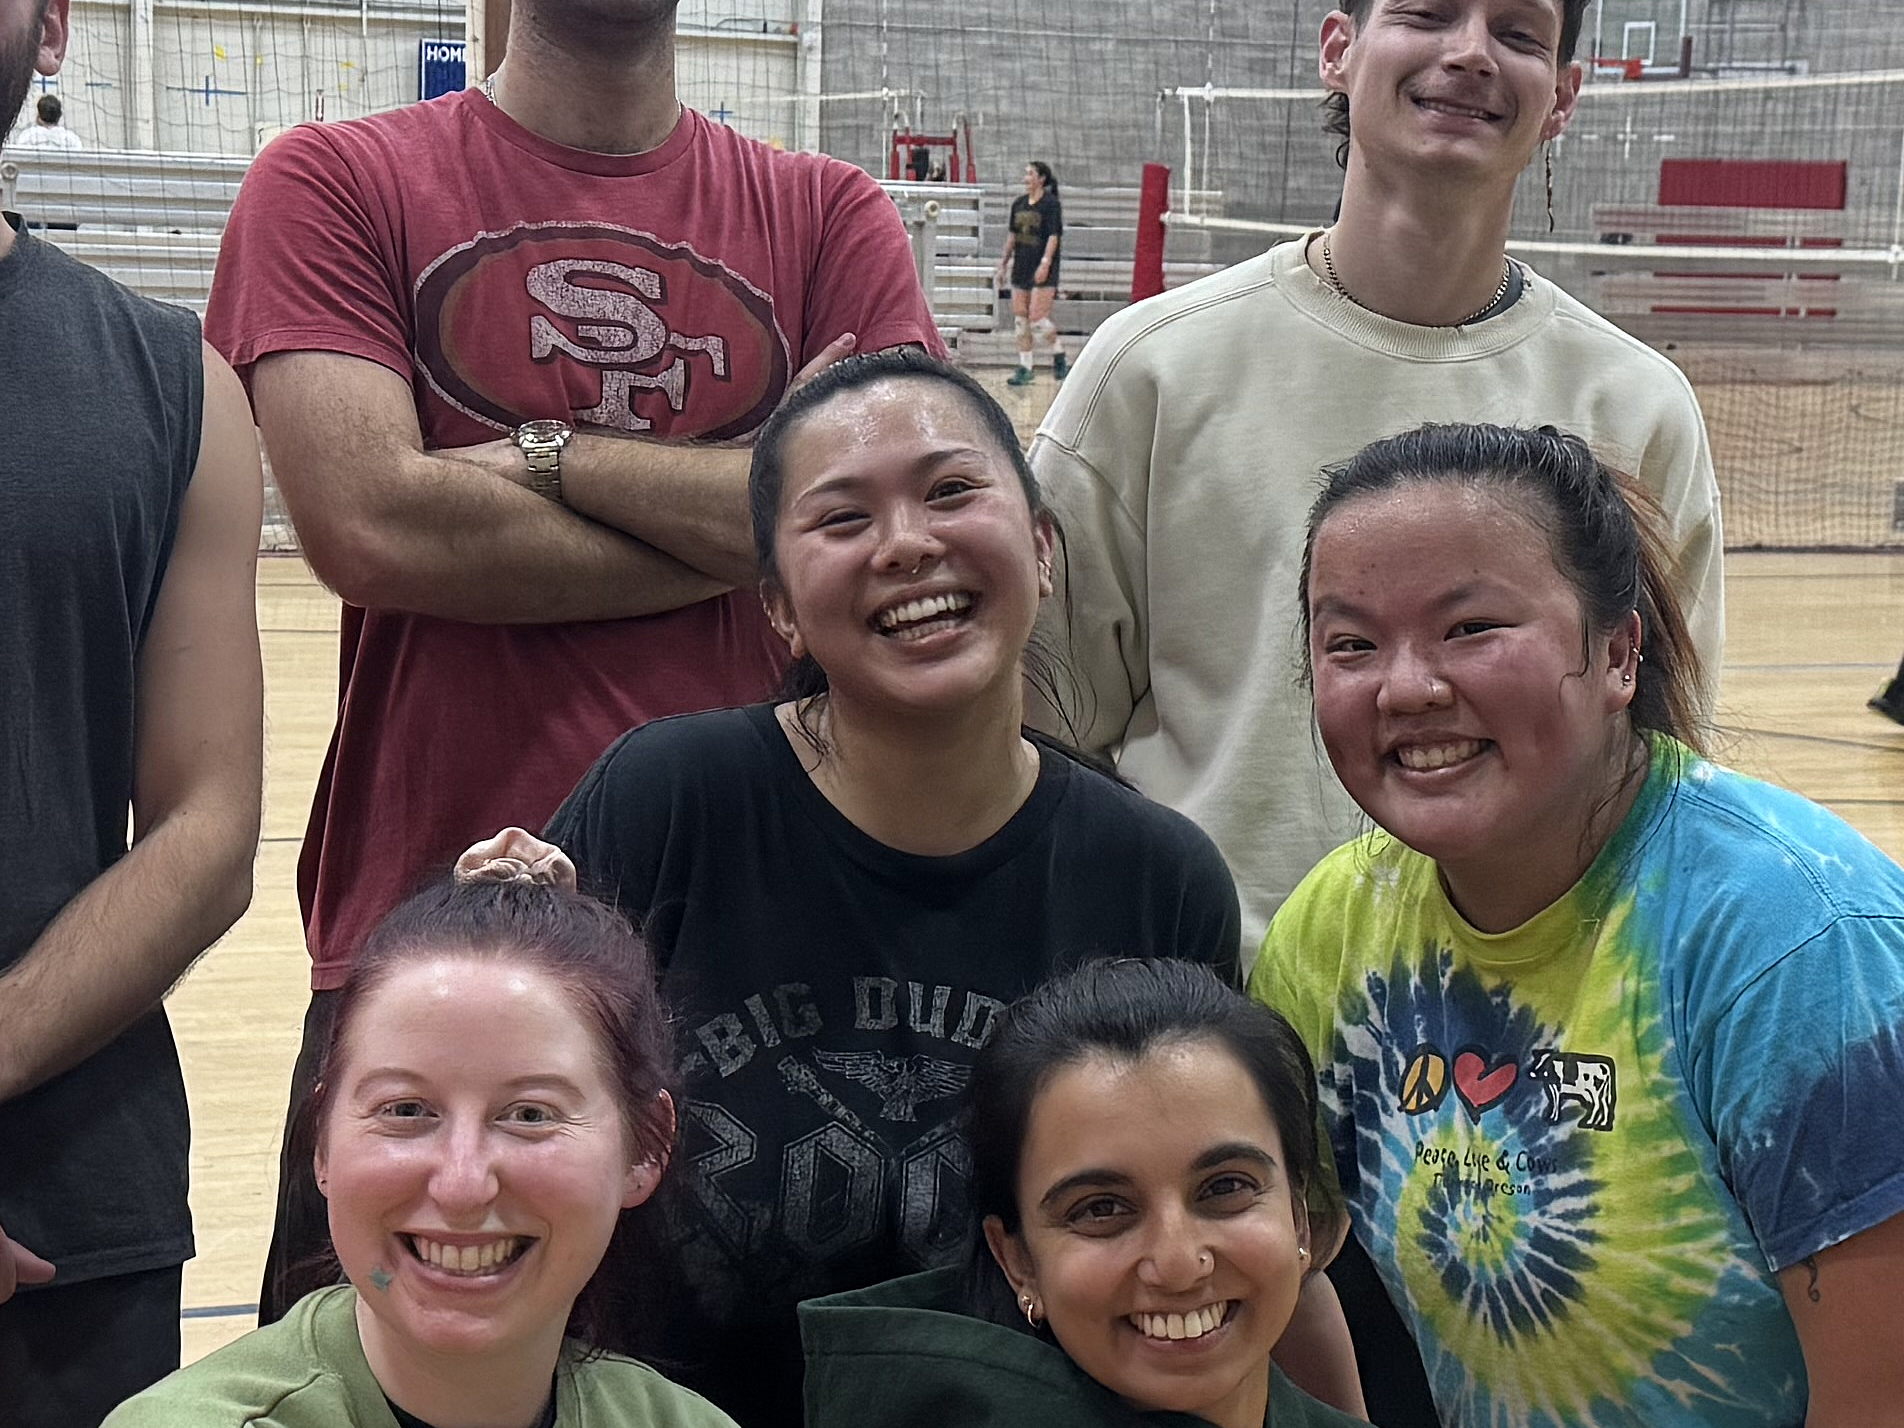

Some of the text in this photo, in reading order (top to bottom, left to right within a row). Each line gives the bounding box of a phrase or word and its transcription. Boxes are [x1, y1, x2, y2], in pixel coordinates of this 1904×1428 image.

[525, 258, 727, 432] SF
[695, 975, 1006, 1078] BIG DUD
[1463, 1146, 1491, 1172] Le
